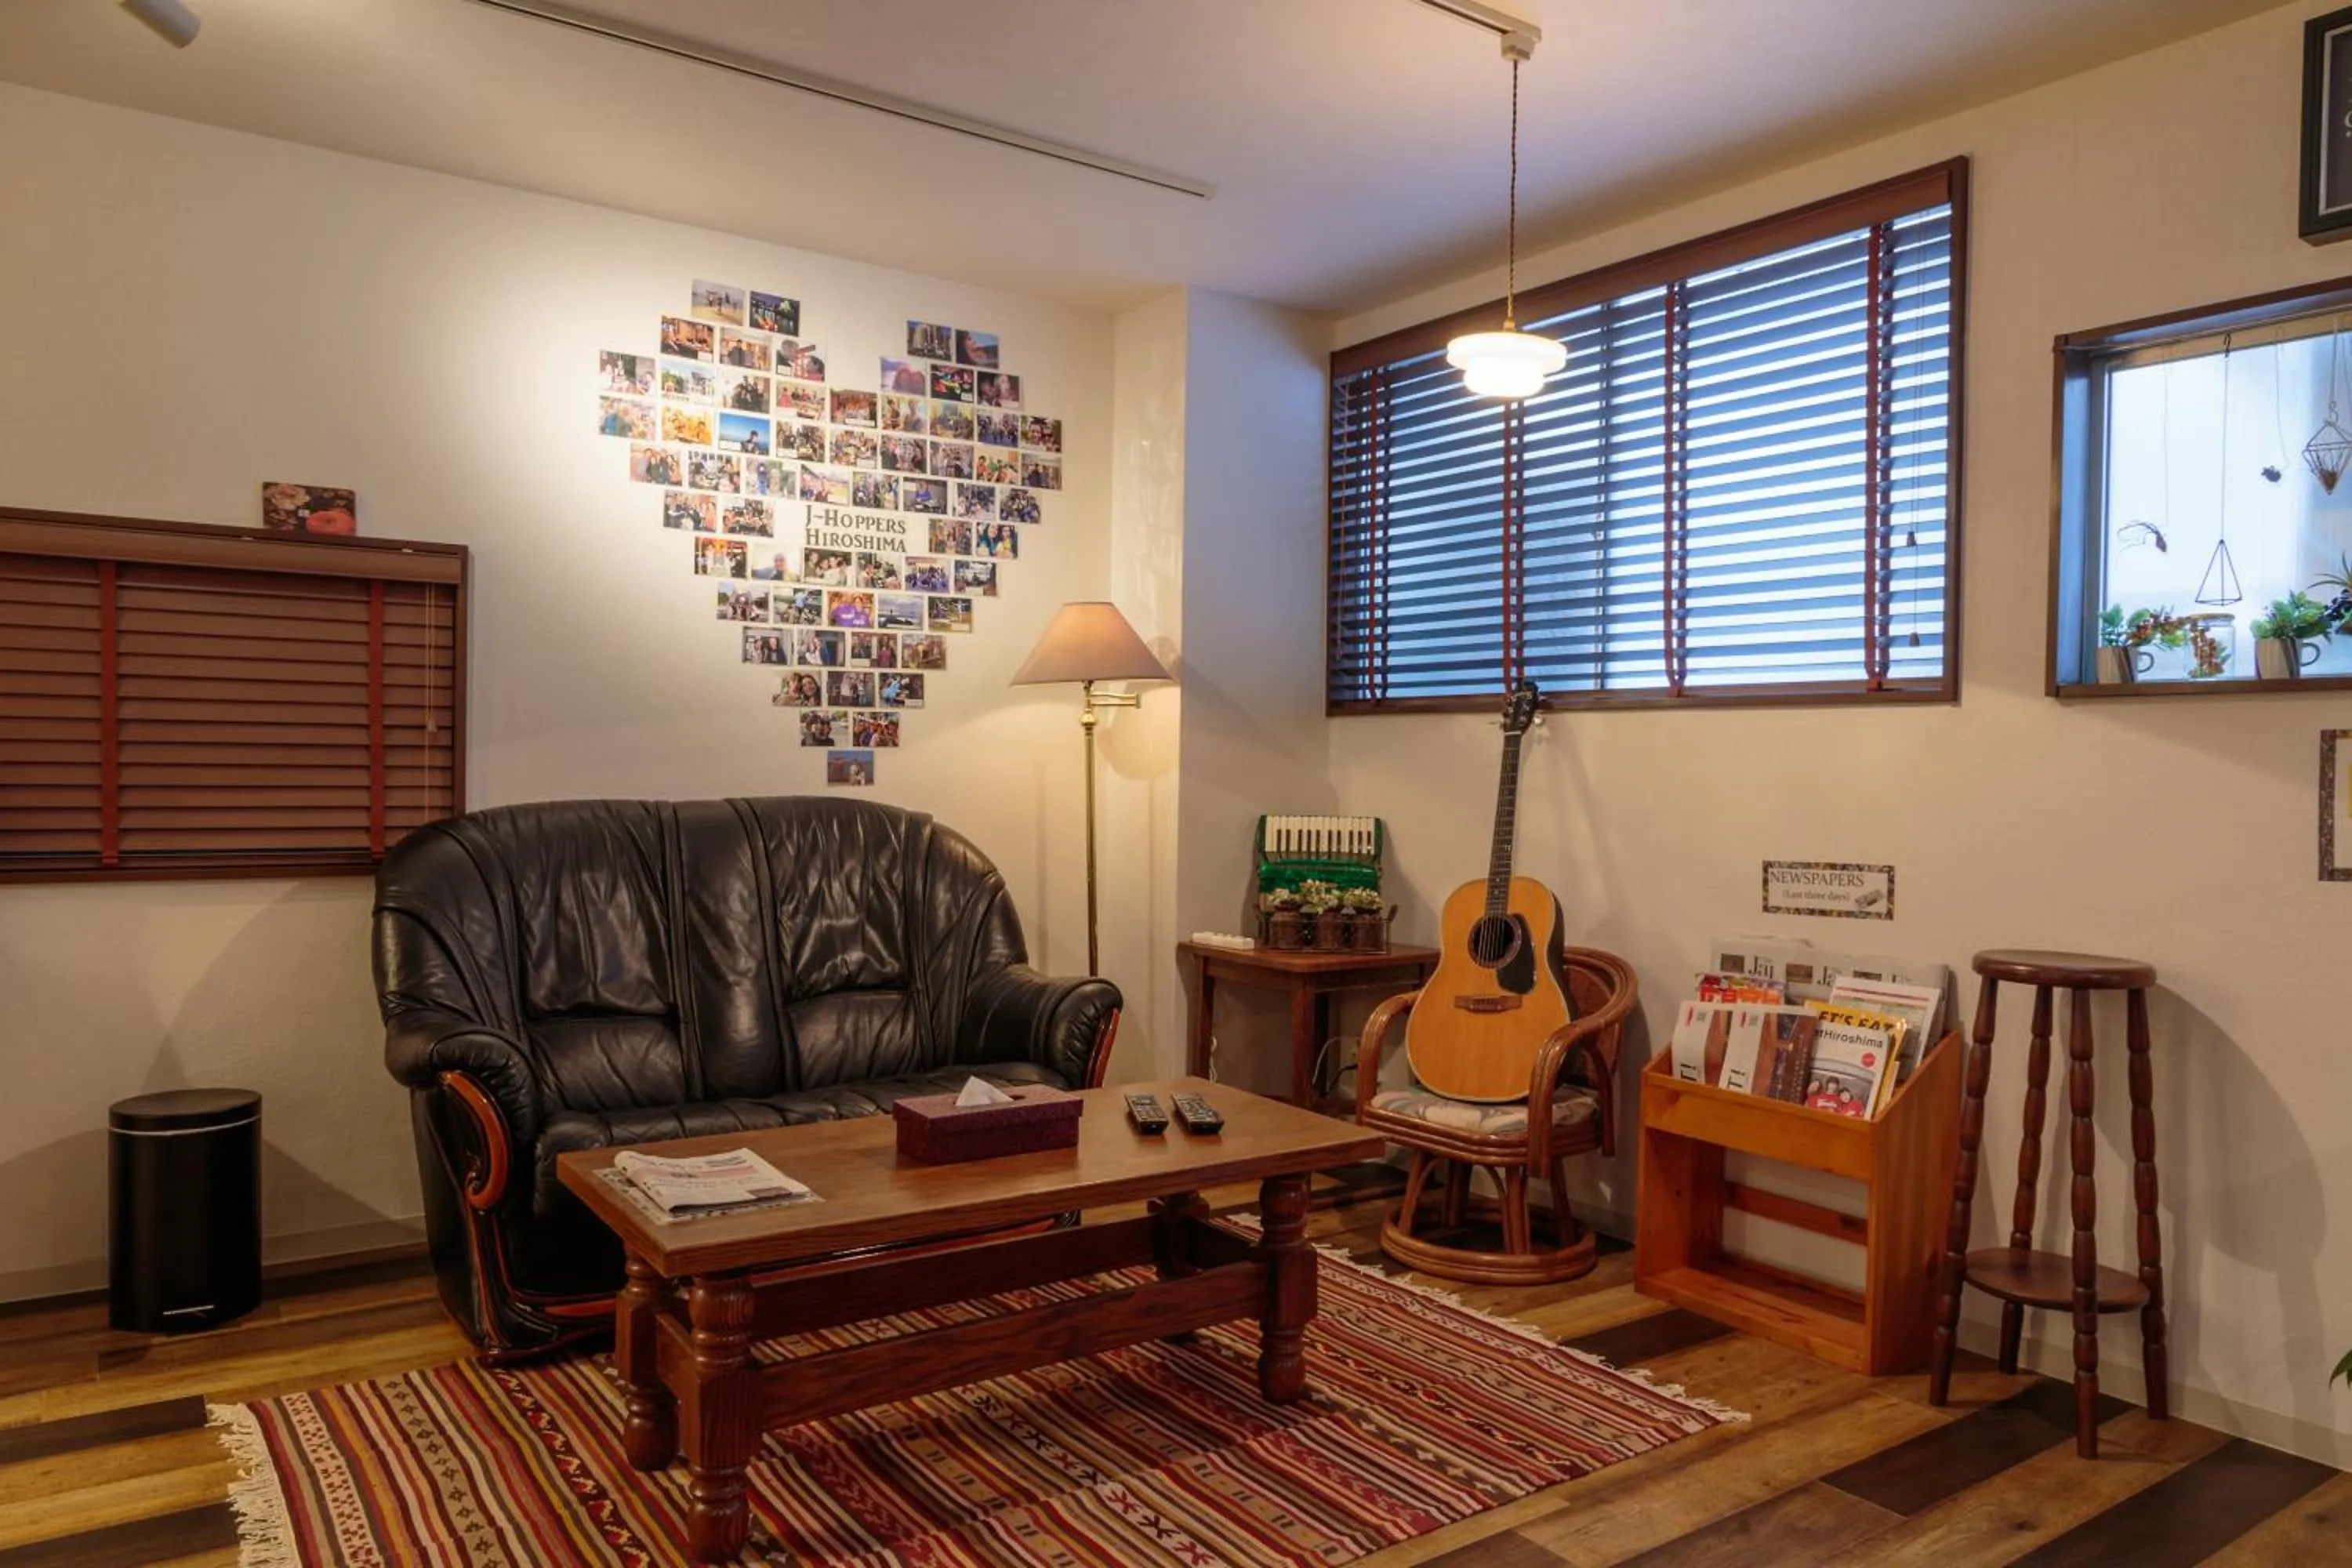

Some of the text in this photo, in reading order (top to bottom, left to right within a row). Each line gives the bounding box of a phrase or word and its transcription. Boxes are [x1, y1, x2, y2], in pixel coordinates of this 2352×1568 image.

[806, 505, 906, 534] J-HOPPERS
[806, 528, 907, 552] HIROSHIMA
[1769, 871, 1864, 887] NEWSPAPERS
[1818, 1011, 1853, 1026] ET'S
